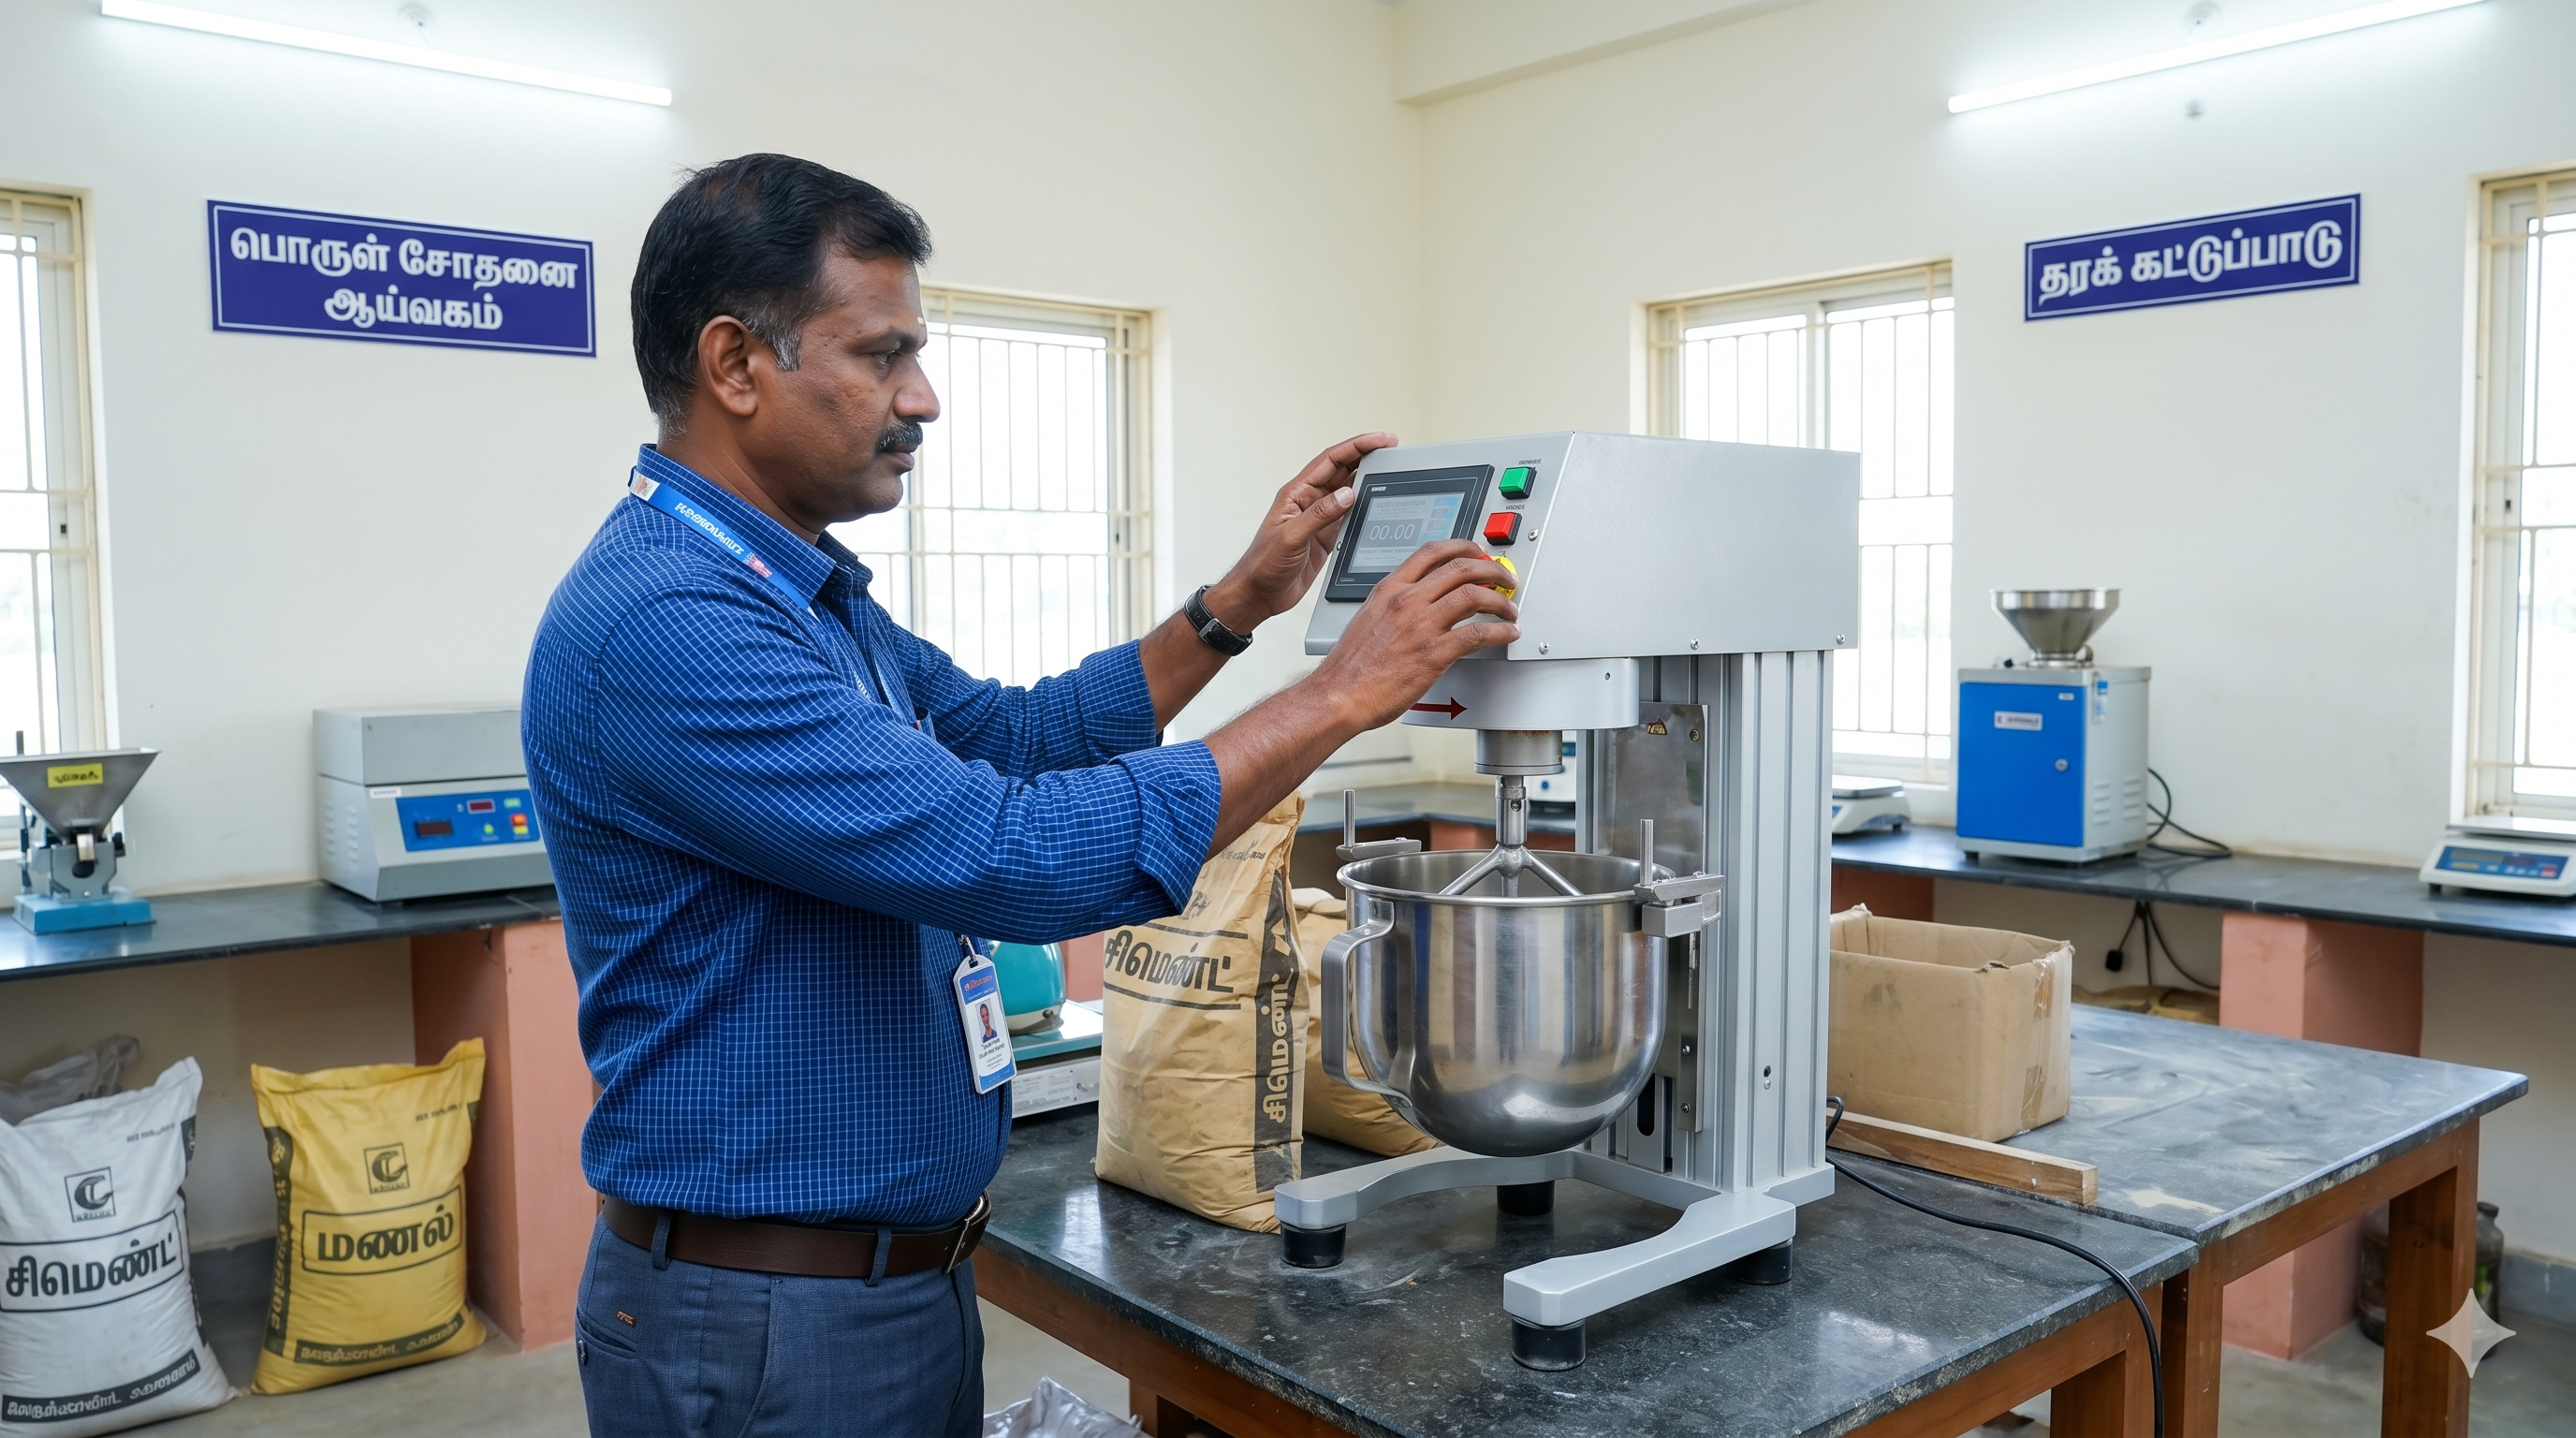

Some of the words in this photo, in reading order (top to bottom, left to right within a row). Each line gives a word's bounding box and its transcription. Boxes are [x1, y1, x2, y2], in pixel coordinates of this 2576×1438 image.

[230, 227, 391, 278] பொருள்
[398, 238, 579, 292] சோதனை
[2039, 245, 2123, 307] தரக்
[2130, 219, 2343, 283] கட்டுப்பாடு
[324, 284, 504, 330] ஆய்வகம்
[1105, 930, 1235, 993] சிமெண்ட்
[6, 1232, 177, 1298] சிமெண்ட்
[317, 1204, 454, 1262] மணல்
